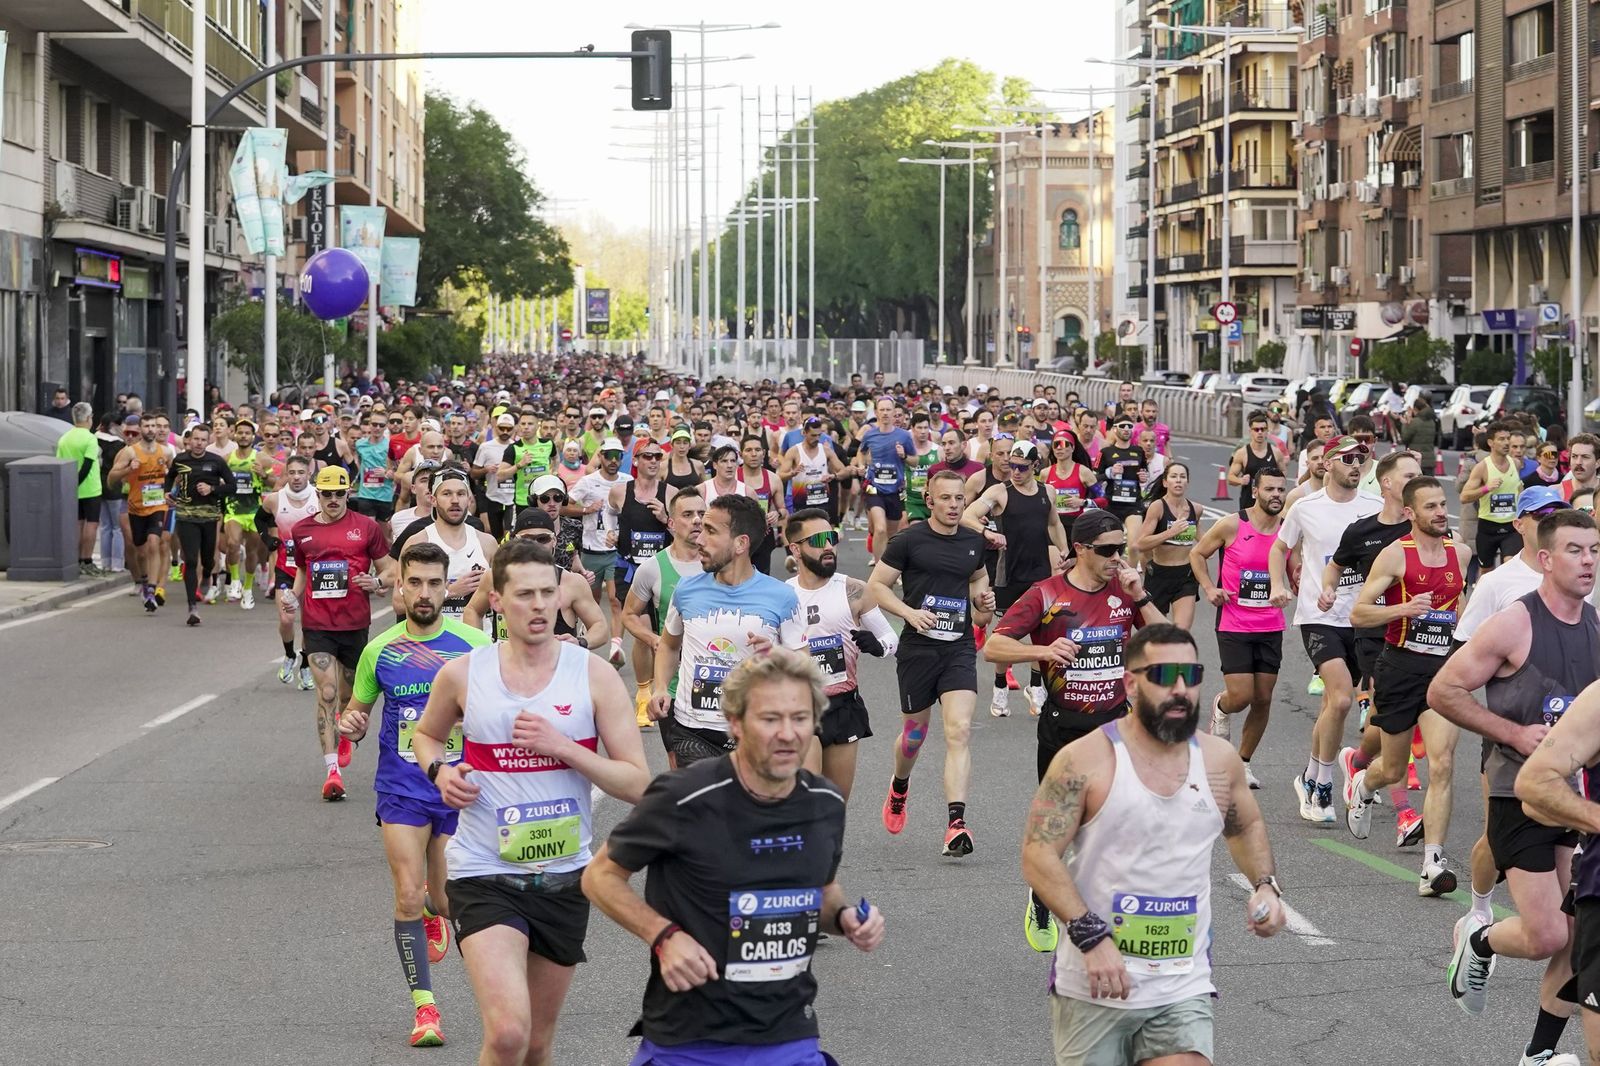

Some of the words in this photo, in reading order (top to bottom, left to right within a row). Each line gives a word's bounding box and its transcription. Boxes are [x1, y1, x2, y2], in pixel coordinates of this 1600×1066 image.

[320, 581, 339, 590] ALEX
[1250, 591, 1268, 599] IBRA
[937, 600, 962, 608] ZURICH
[1109, 608, 1132, 618] AAMA
[1086, 629, 1118, 639] ZURICH
[1415, 633, 1449, 645] ERWAN
[1088, 646, 1105, 654] 4620
[1071, 655, 1120, 669] GONCALO
[499, 757, 562, 769] PHOENIX
[525, 803, 570, 818] ZURICH
[529, 828, 552, 840] 3301
[517, 840, 567, 861] JONNY
[763, 894, 814, 909] ZURICH
[1144, 901, 1189, 912] ZURICH
[763, 922, 792, 936] 4133
[1144, 925, 1170, 936] 1623
[741, 937, 807, 961] CARLOS
[1118, 939, 1188, 956] ALBERTO
